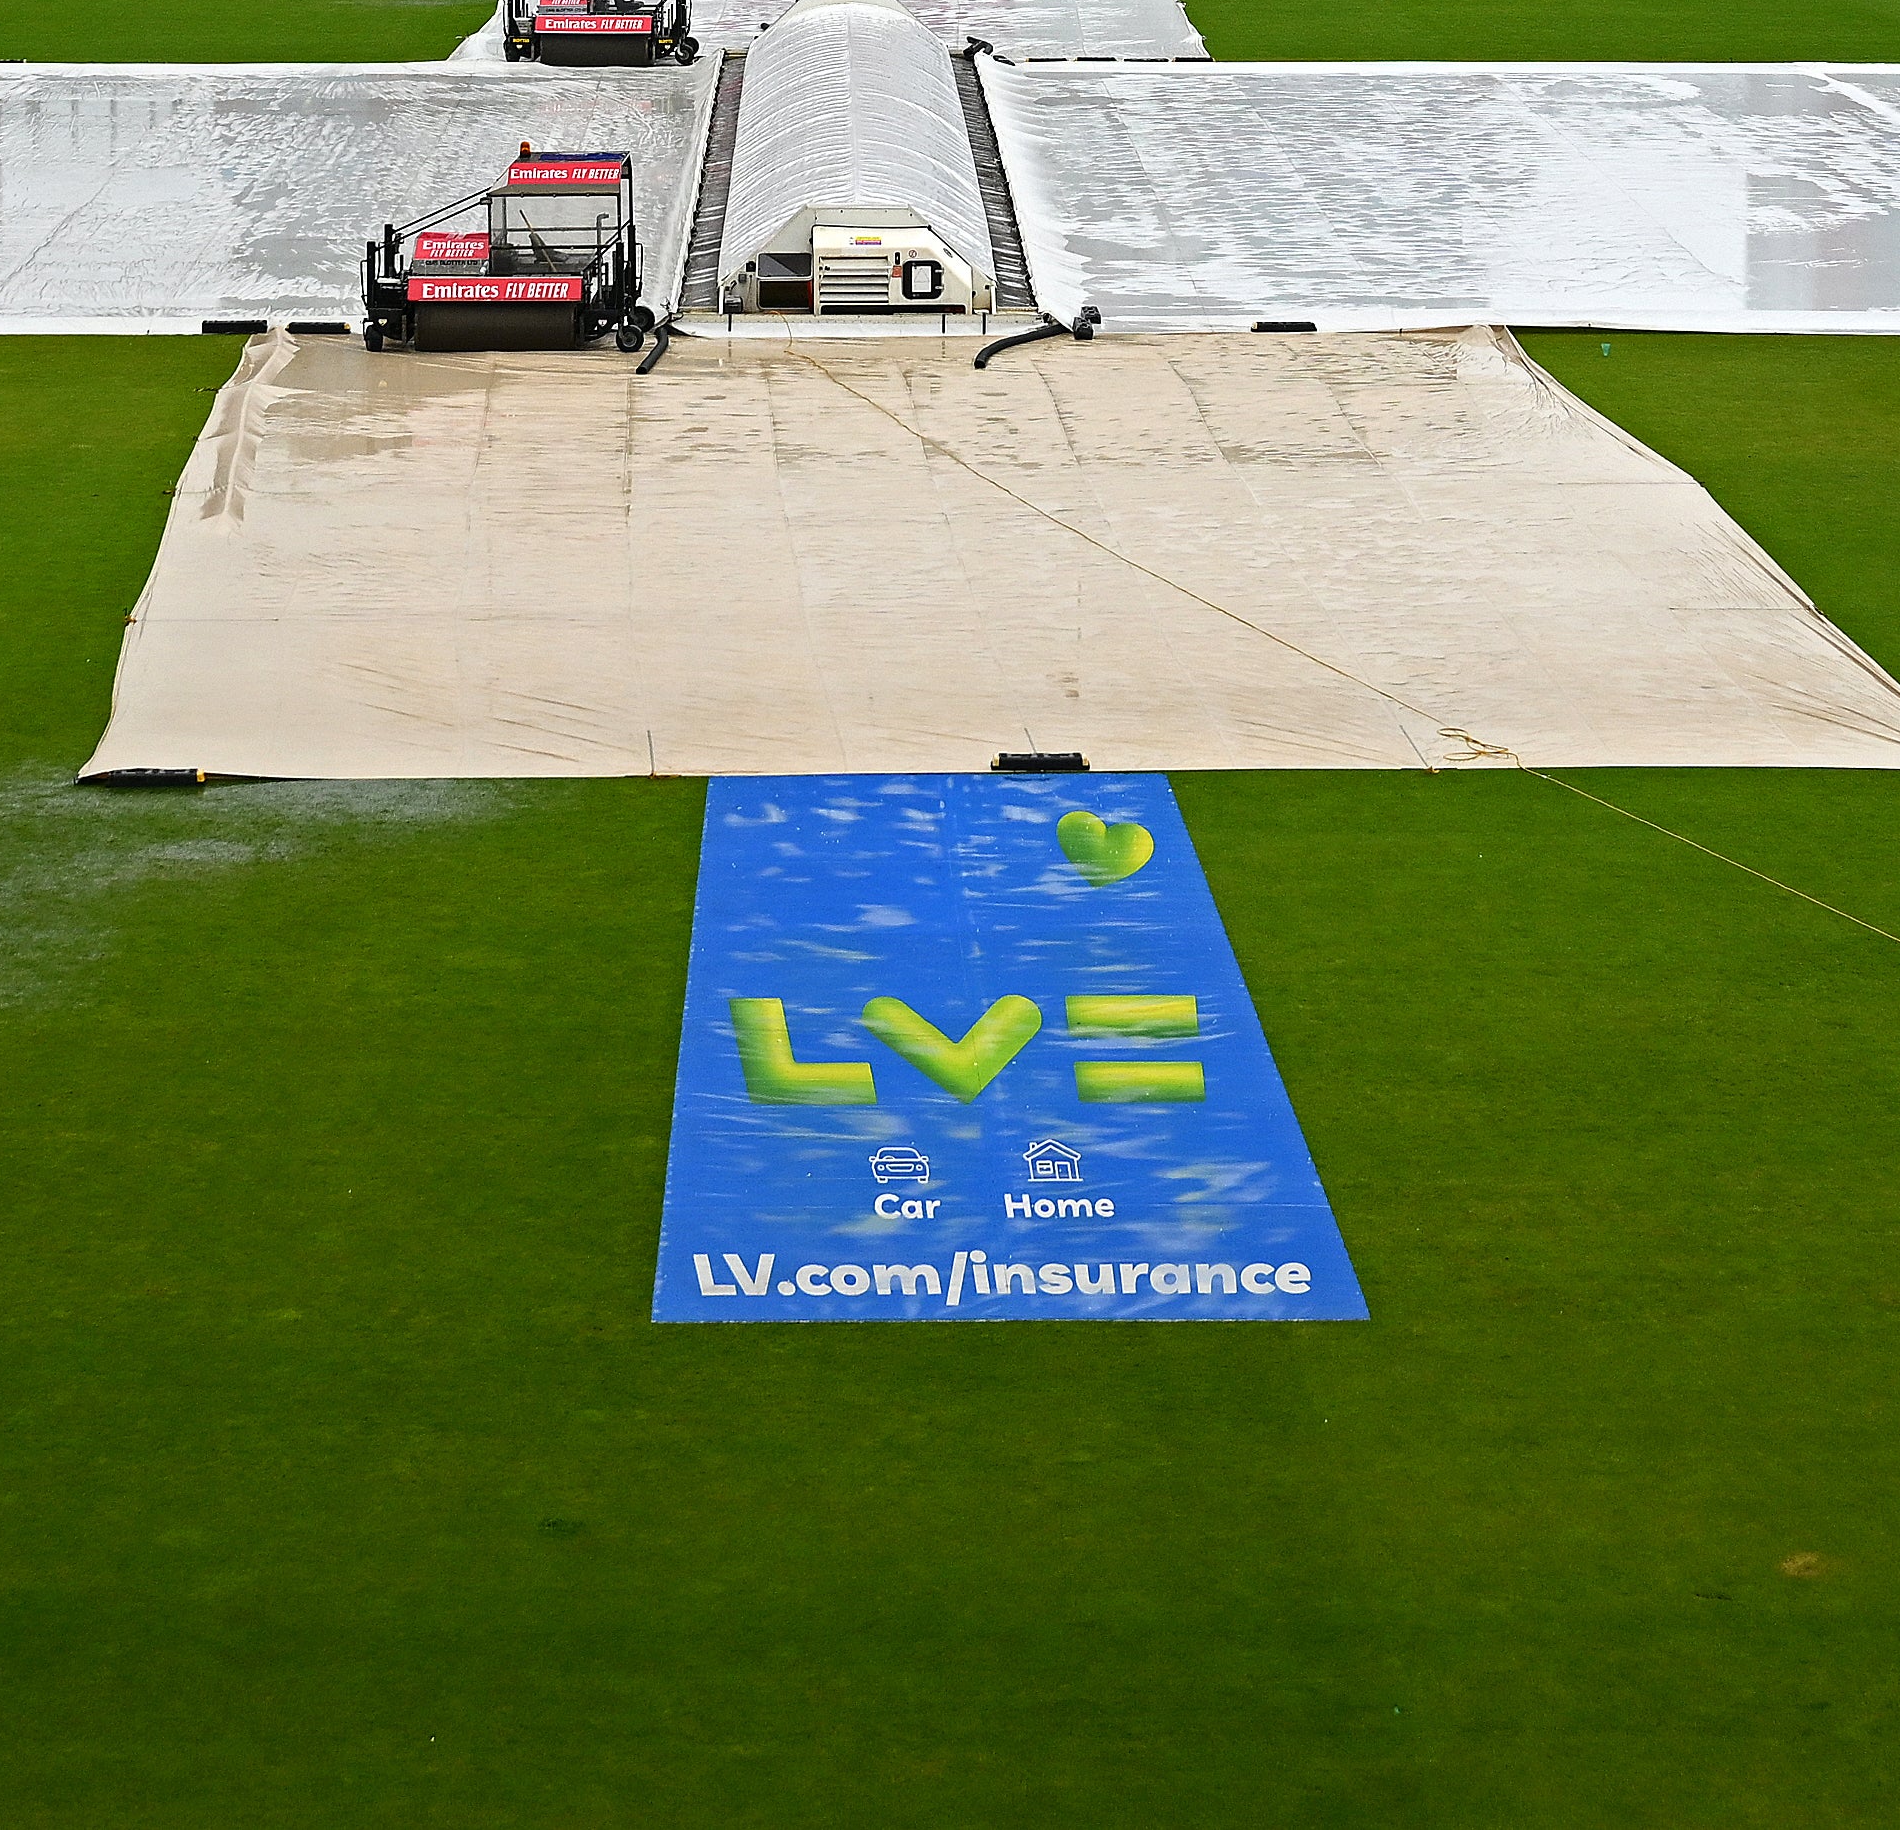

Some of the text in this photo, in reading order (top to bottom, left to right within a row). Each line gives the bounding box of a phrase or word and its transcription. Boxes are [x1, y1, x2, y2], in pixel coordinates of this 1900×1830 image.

[545, 20, 644, 30] Emirates FLY BETTER
[510, 168, 620, 180] Emirates FLY BETTER
[422, 240, 485, 250] Emirates
[430, 249, 475, 257] FLY BETTER
[422, 282, 569, 299] Emirates FLY BETTER
[873, 1192, 1115, 1221] Car Home
[693, 1250, 1312, 1307] LV.com/insurance
